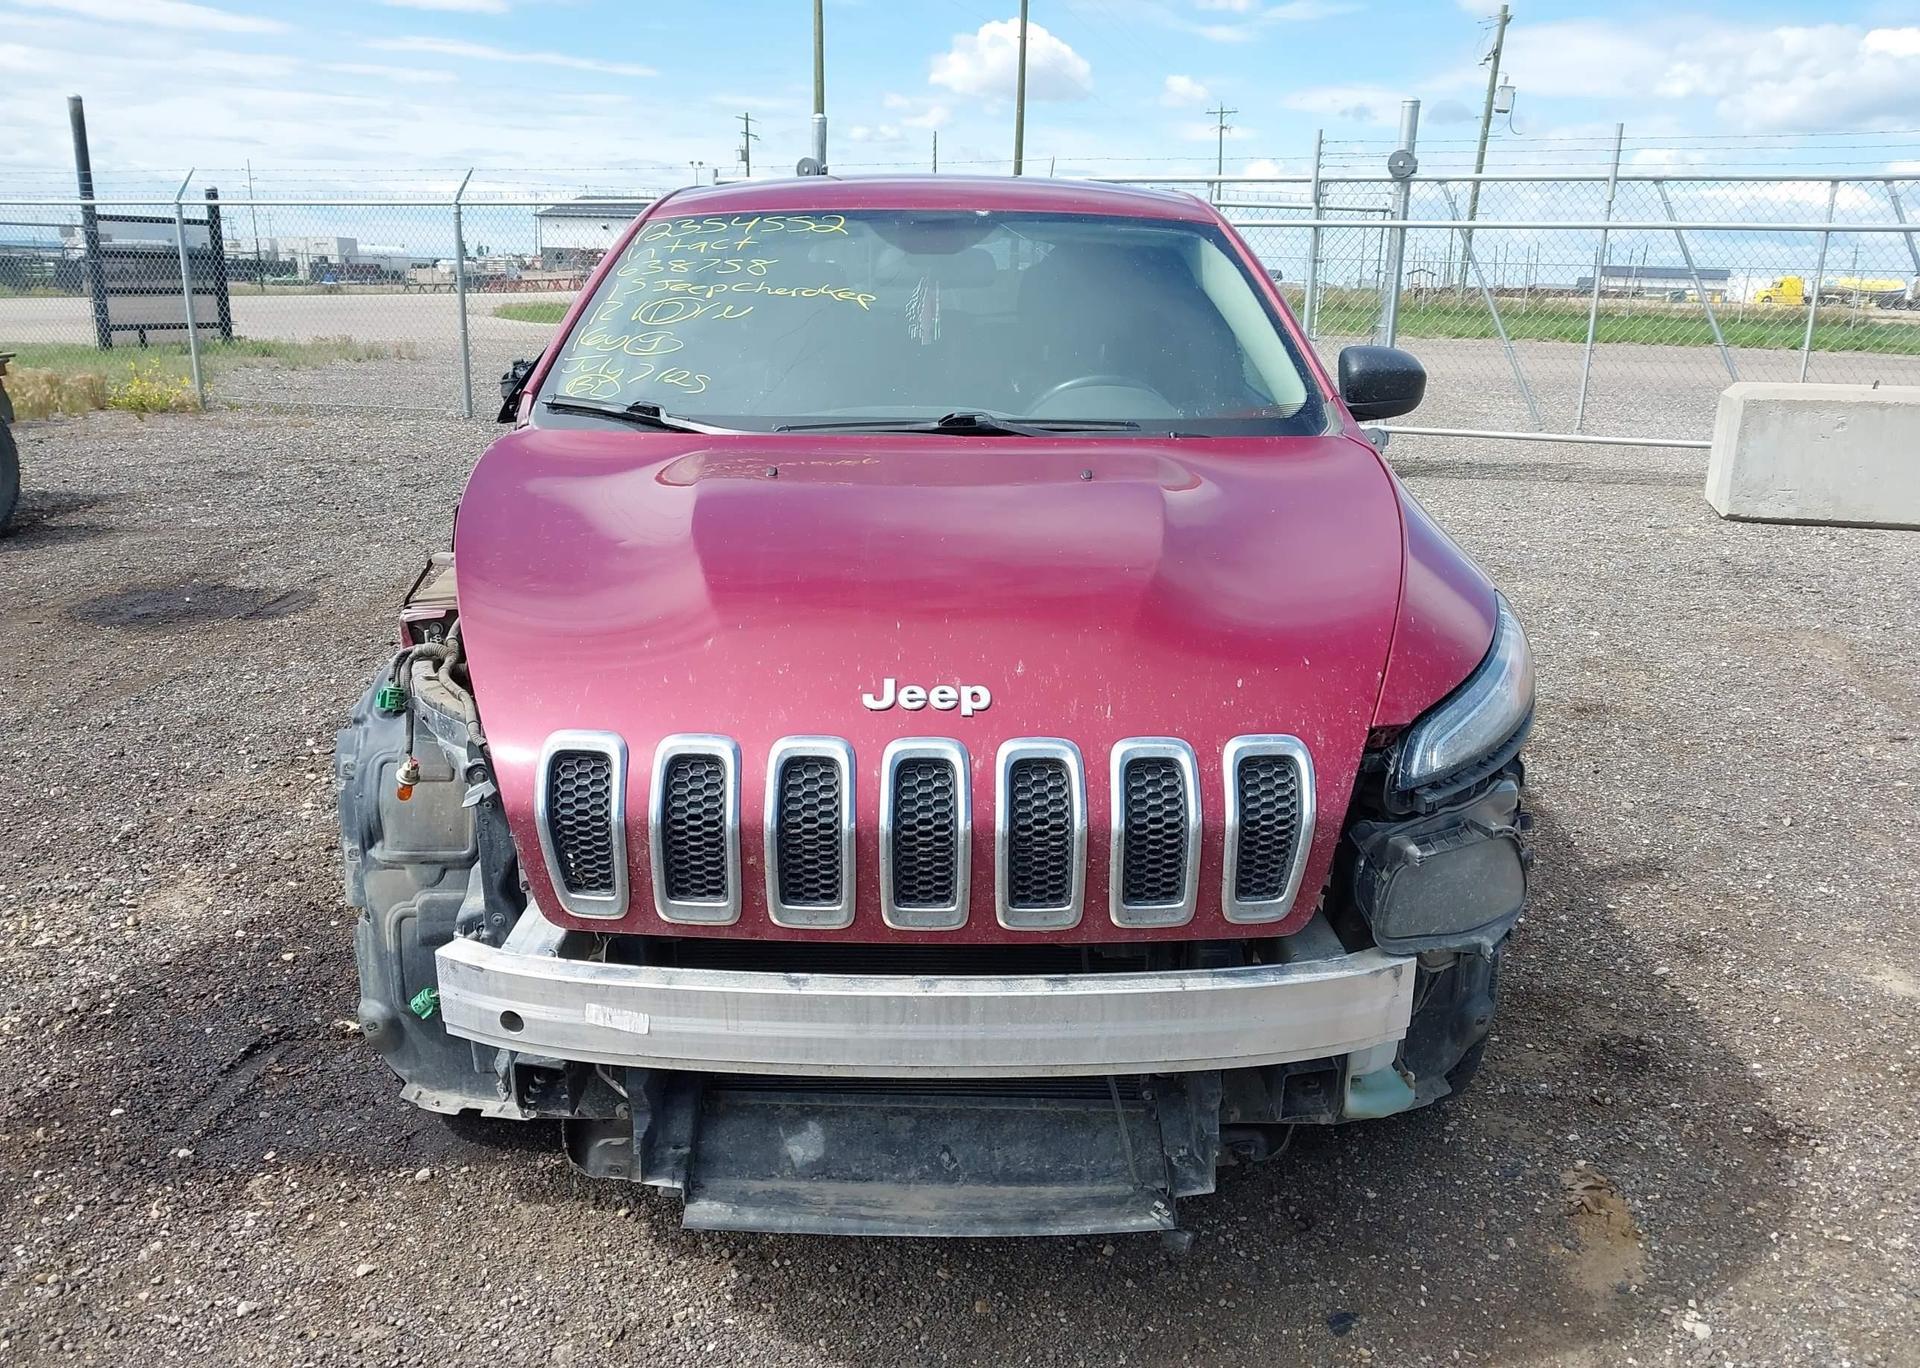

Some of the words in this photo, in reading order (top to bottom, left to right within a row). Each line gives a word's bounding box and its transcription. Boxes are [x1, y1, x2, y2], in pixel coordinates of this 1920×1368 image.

[634, 214, 849, 245] 12354552
[616, 259, 779, 277] 638758
[653, 279, 728, 298] Jeep
[561, 355, 625, 383] July
[862, 678, 992, 718] Jeep
